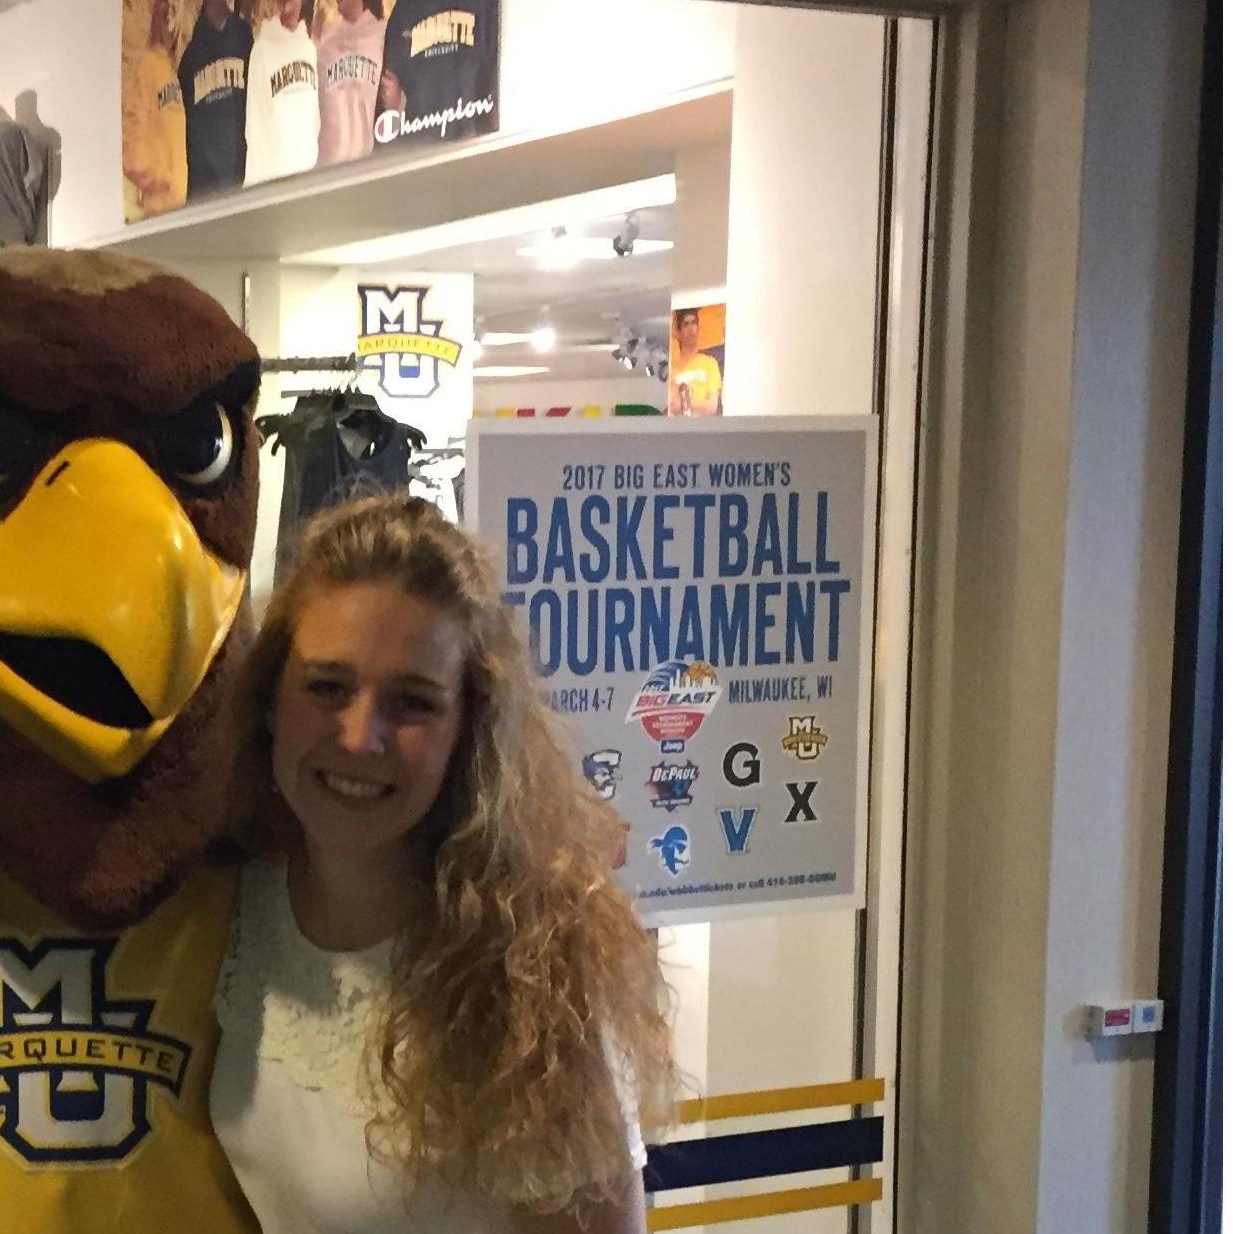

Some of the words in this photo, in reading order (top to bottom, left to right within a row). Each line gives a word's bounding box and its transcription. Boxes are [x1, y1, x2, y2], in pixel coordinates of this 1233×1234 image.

[374, 95, 493, 143] Champion
[563, 464, 605, 490] 2017
[614, 464, 644, 489] BIG
[653, 463, 701, 488] EAST
[708, 462, 791, 488] WOMEN'S
[506, 492, 841, 585] BASKETBALL
[592, 687, 614, 712] 4-7
[729, 678, 810, 704] MILWAUKEE,
[817, 676, 832, 698] WI
[723, 743, 760, 787] G
[784, 781, 818, 823] X
[719, 808, 756, 853] V
